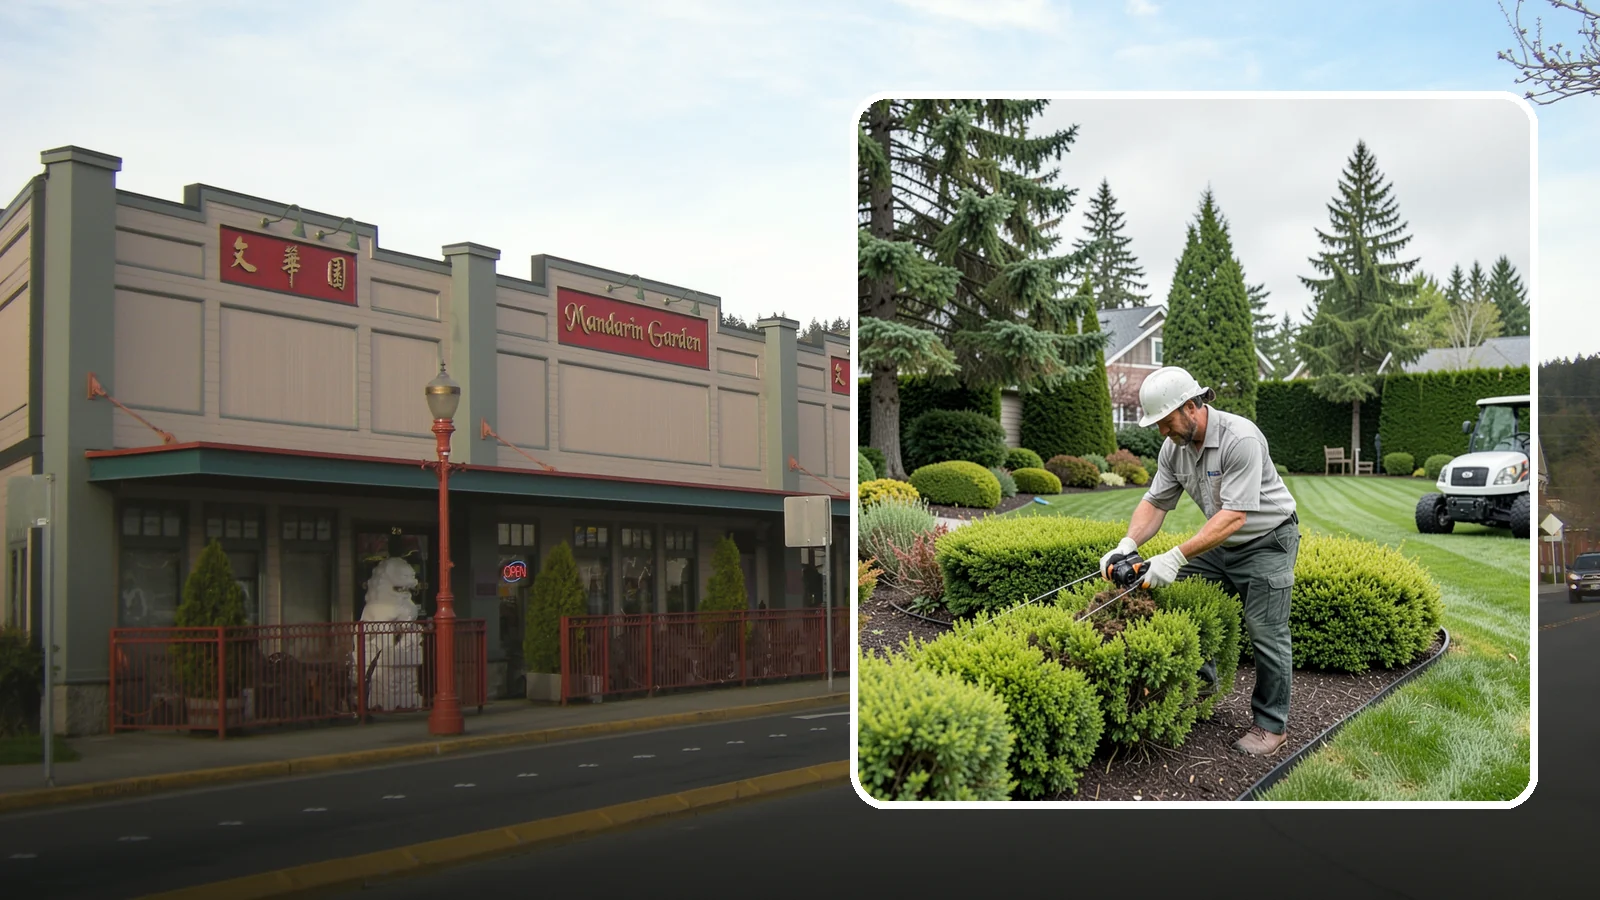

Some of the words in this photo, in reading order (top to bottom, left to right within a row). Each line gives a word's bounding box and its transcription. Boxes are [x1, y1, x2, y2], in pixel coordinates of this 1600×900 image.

[231, 236, 346, 290] 文華園
[565, 302, 643, 340] Mandarin
[648, 320, 701, 352] Garden
[835, 363, 846, 386] 文
[503, 565, 527, 578] OPEN
